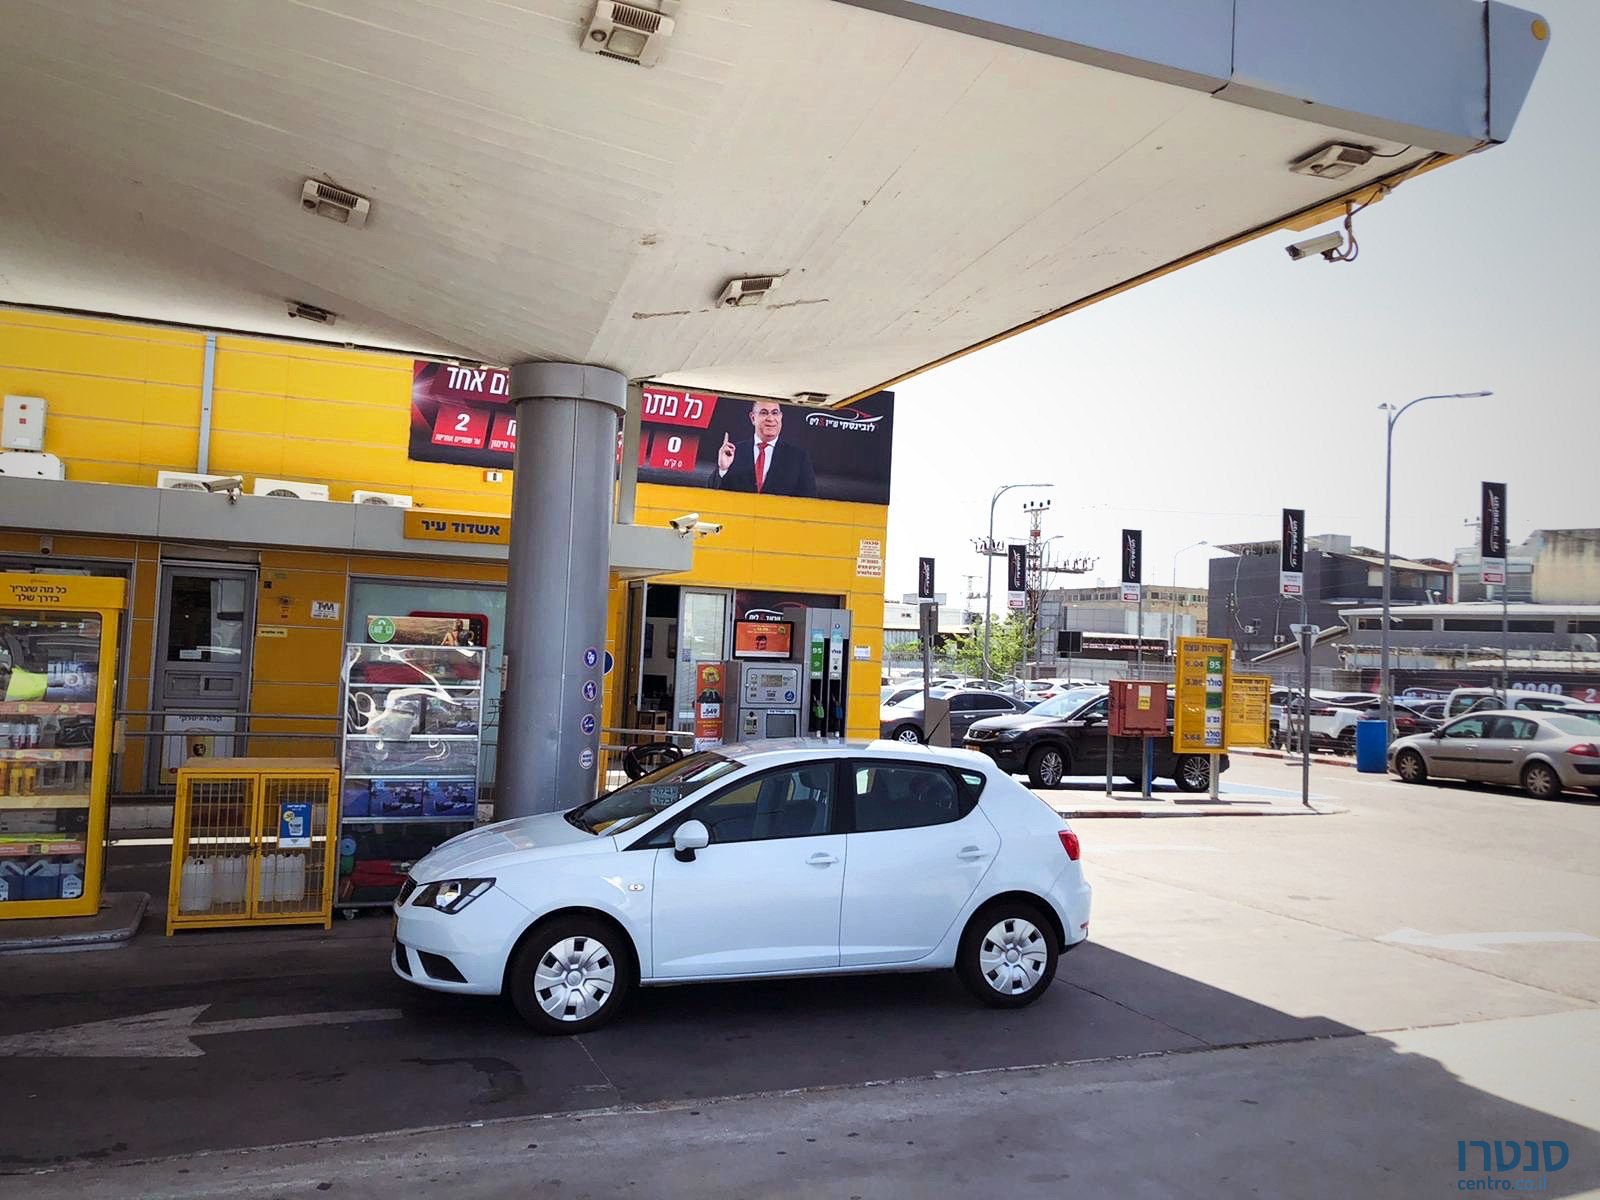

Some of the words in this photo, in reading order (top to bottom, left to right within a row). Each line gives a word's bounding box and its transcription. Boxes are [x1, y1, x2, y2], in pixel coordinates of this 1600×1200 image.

[447, 367, 487, 392] אחד
[684, 393, 703, 419] כל
[455, 413, 470, 432] 2
[667, 436, 682, 453] 0
[421, 520, 447, 532] עיר
[452, 522, 500, 535] אשדוד
[55, 586, 67, 594] כל
[16, 593, 35, 602] שלך
[1209, 660, 1221, 669] 95
[1206, 678, 1222, 687] סולר
[1206, 730, 1221, 738] סולר
